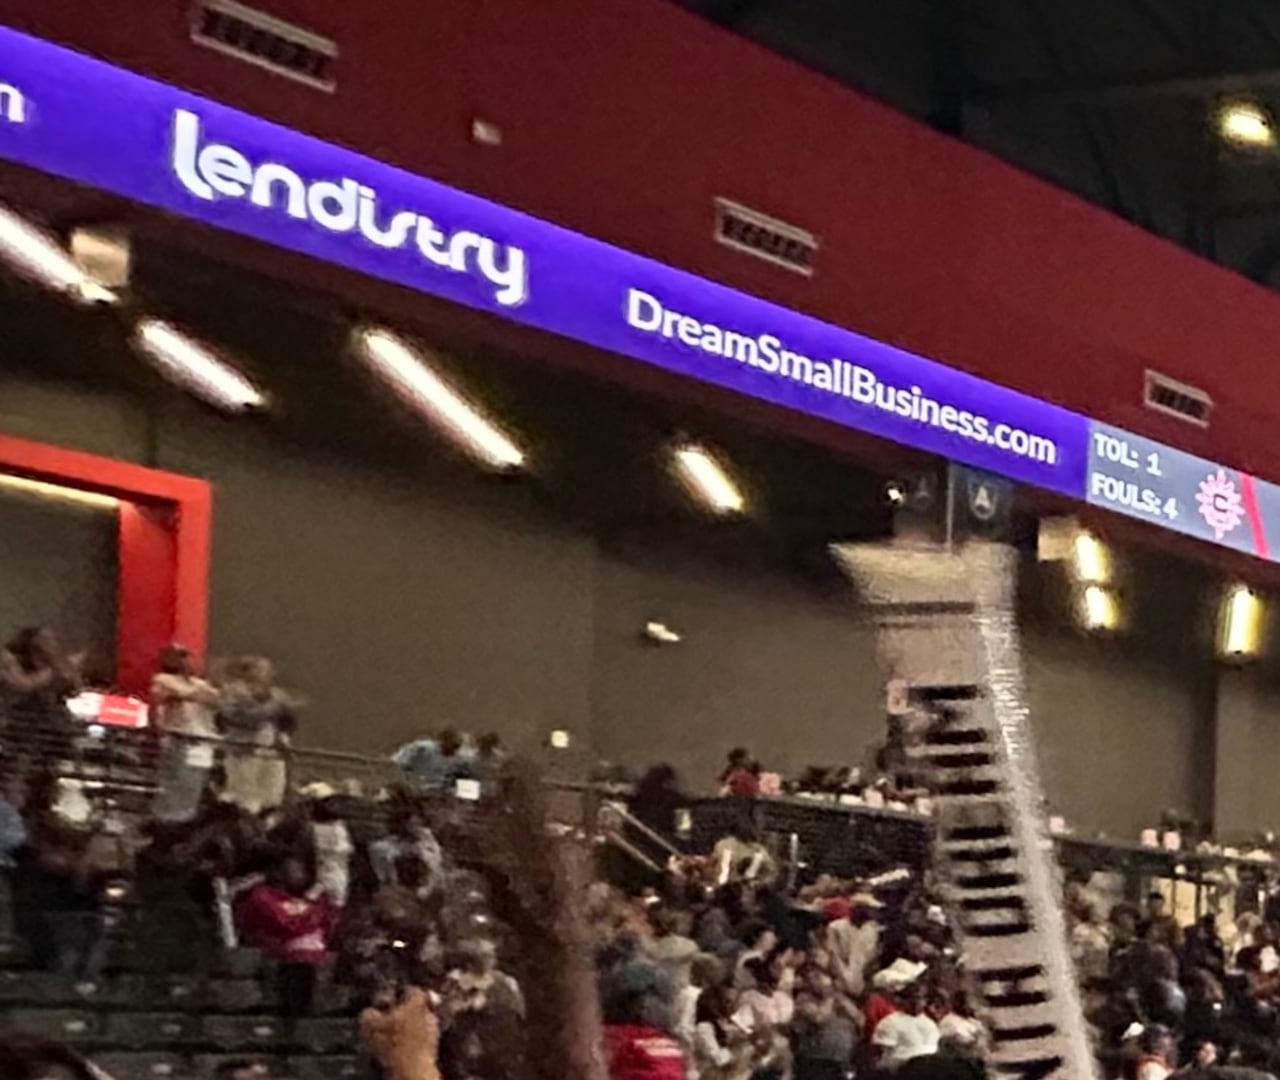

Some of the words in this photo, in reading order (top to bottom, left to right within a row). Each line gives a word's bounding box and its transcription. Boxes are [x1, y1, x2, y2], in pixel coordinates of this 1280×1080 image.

[626, 288, 1058, 465] DreamSmallBusiness.com
[1093, 433, 1139, 468] TOL:
[1147, 453, 1162, 476] 1
